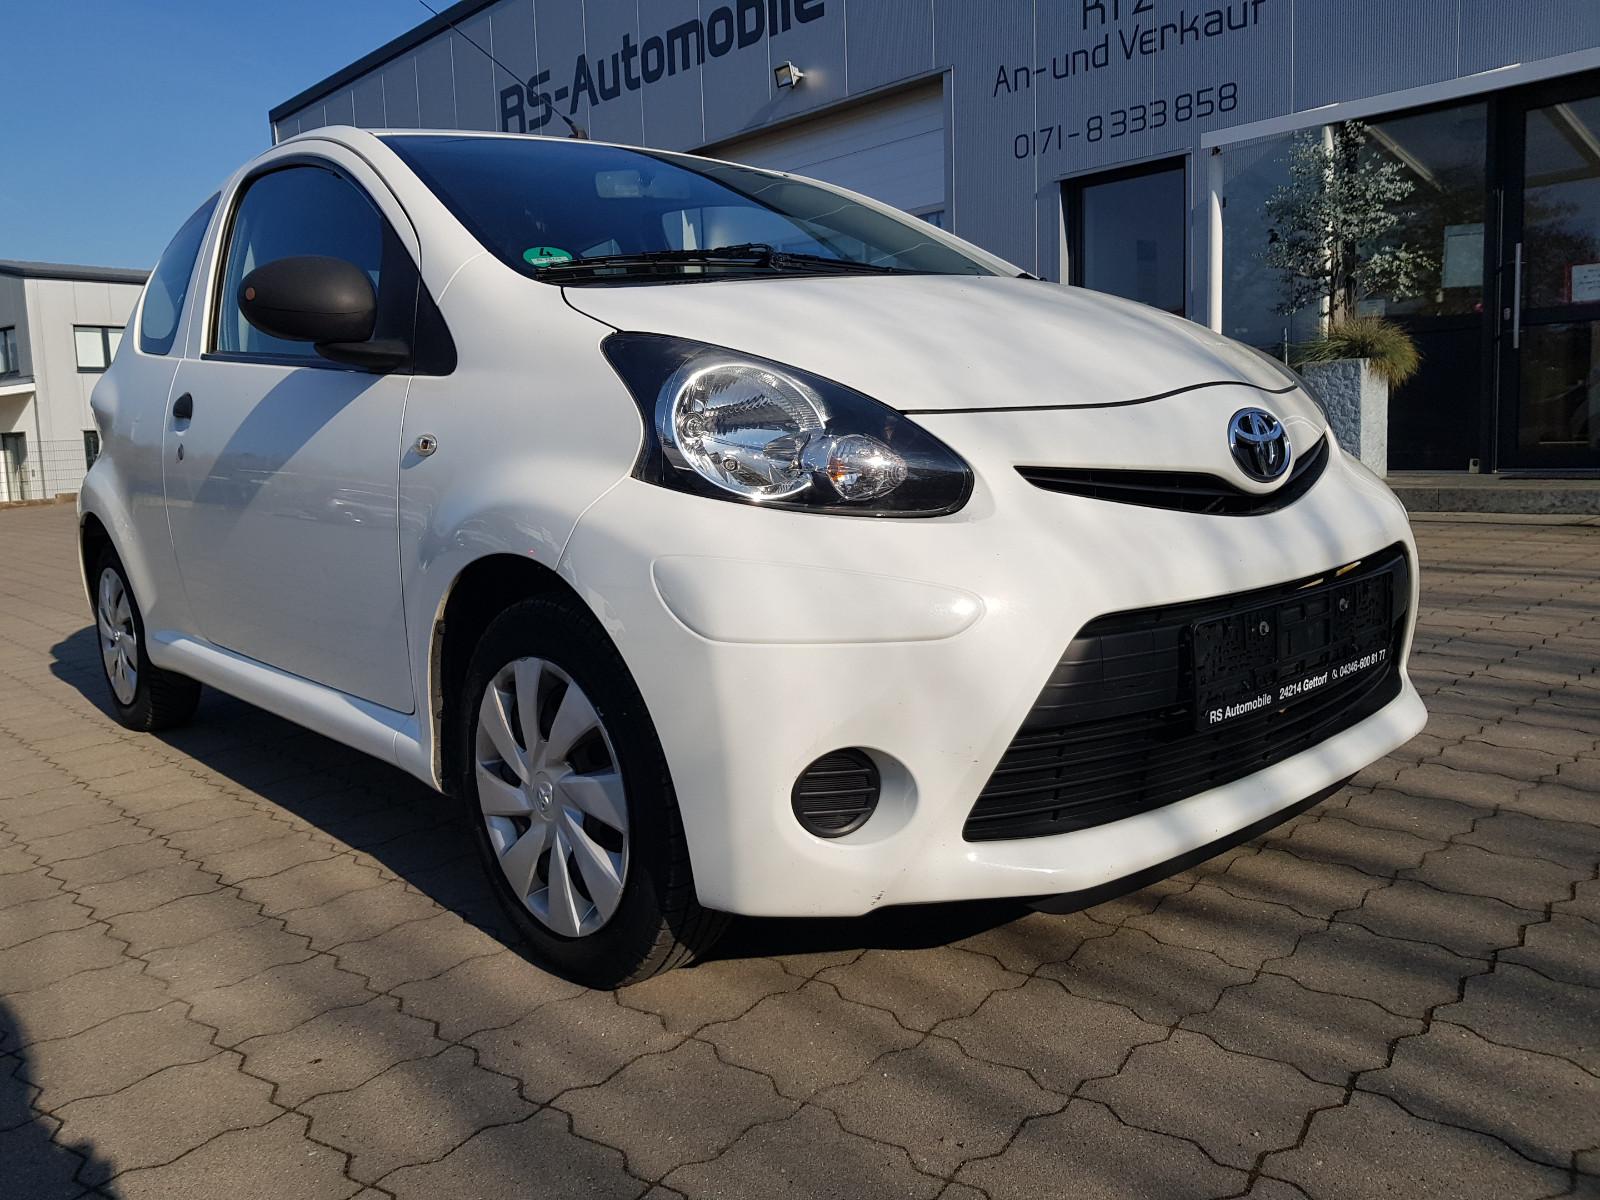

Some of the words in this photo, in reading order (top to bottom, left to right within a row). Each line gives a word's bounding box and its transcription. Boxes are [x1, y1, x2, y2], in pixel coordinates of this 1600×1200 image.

[1118, 0, 1267, 61] Verkauf
[1209, 708, 1223, 724] RS
[1224, 693, 1272, 720] Automobile
[1279, 681, 1302, 700] 24214
[1303, 671, 1328, 692] Gettorf
[1379, 648, 1386, 661] 77
